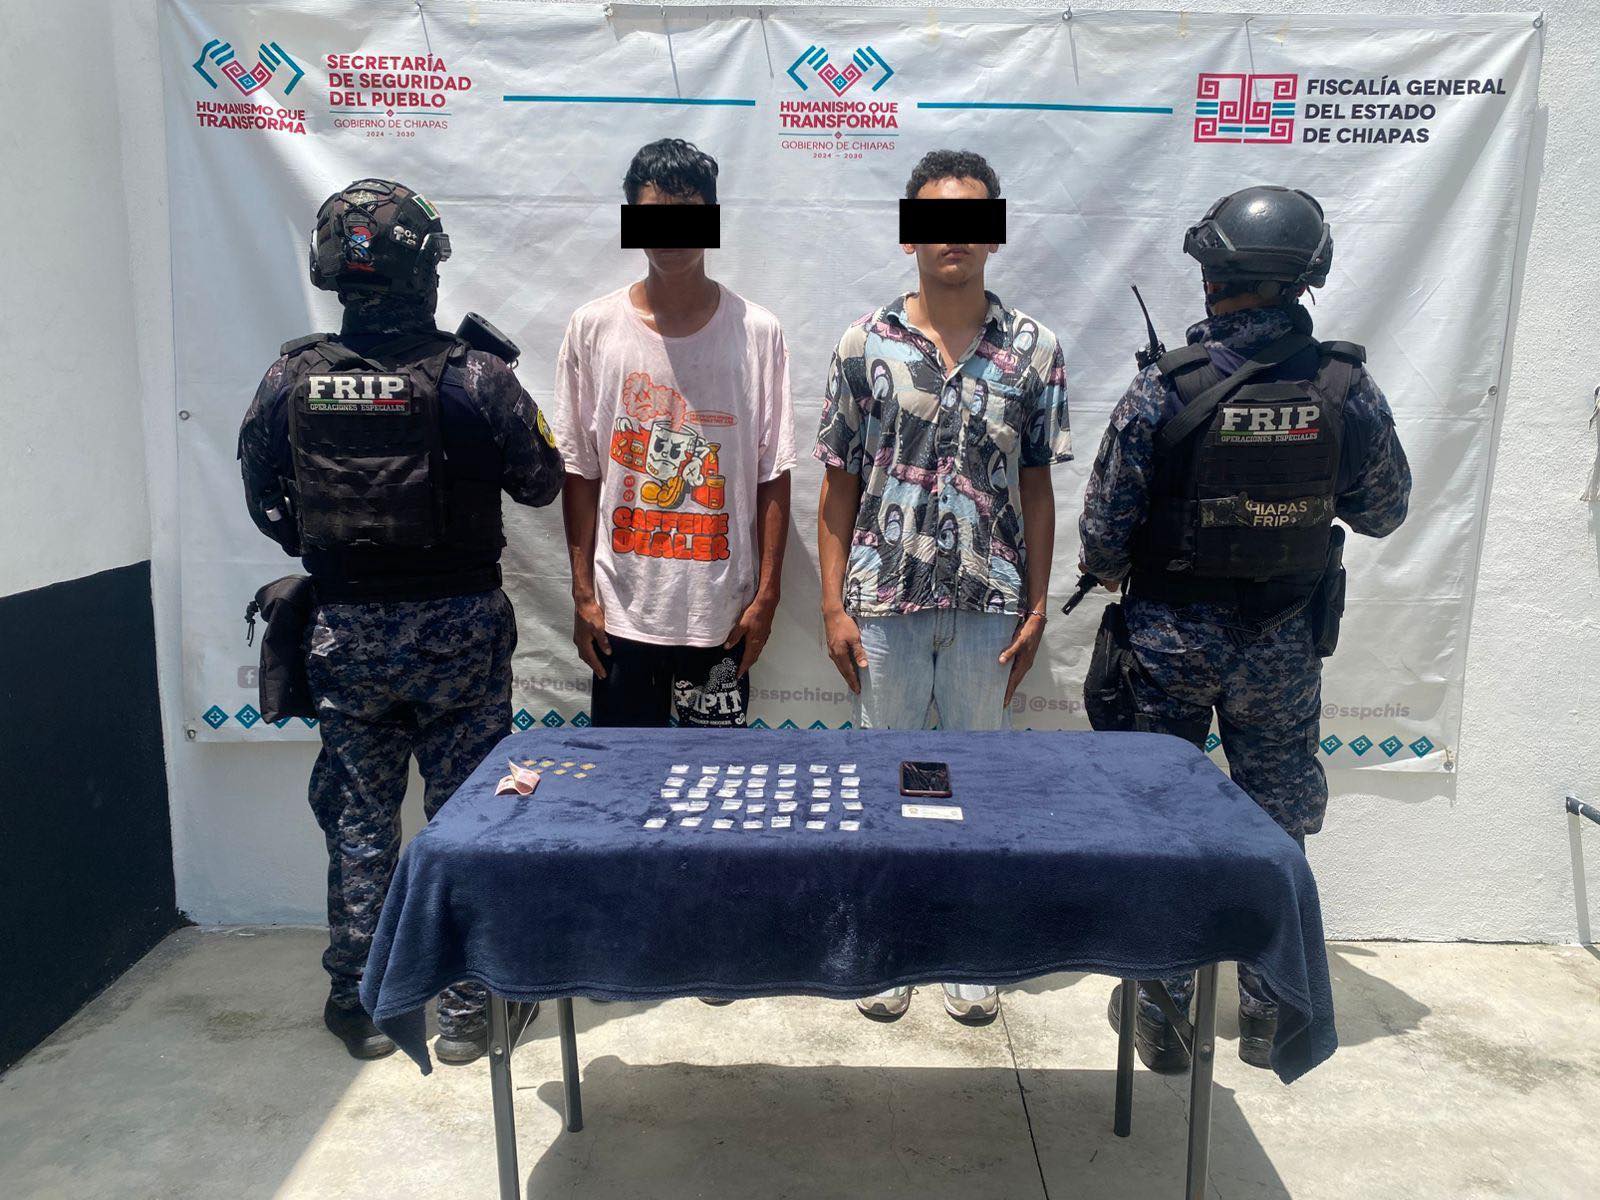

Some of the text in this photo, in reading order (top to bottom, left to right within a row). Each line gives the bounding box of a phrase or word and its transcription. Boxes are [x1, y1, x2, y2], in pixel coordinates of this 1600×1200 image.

[327, 53, 447, 73] SECRETARÍA
[329, 73, 472, 91] DE SEGURIDAD
[1307, 75, 1506, 95] FISCALÍA GENERAL
[330, 91, 446, 108] DEL PUEBLO
[780, 101, 898, 115] HUMANISMO QUE
[196, 101, 305, 122] HUMANISMO QUE
[1304, 103, 1436, 120] DEL ESTADO
[196, 113, 306, 135] TRANSFORMA
[334, 119, 448, 130] GOBIERNO DE CHIAPAS
[779, 114, 898, 129] TRANSFORMA
[1302, 127, 1429, 144] DE CHIAPAS
[781, 140, 895, 150] GOBIERNO DE CHIAPAS
[309, 376, 405, 399] FRIP
[309, 403, 406, 412] OPERACIONES ESPECIALES
[1221, 405, 1320, 431] FRIP
[1221, 432, 1318, 442] OPERACIONES ESPECIALES
[612, 506, 730, 535] CAFFEINE
[1253, 515, 1290, 527] FRIP
[612, 528, 731, 561] DEALER
[749, 686, 851, 704] @sspchiap
[1029, 696, 1087, 714] @ssp
[1321, 702, 1411, 720] @sspchis
